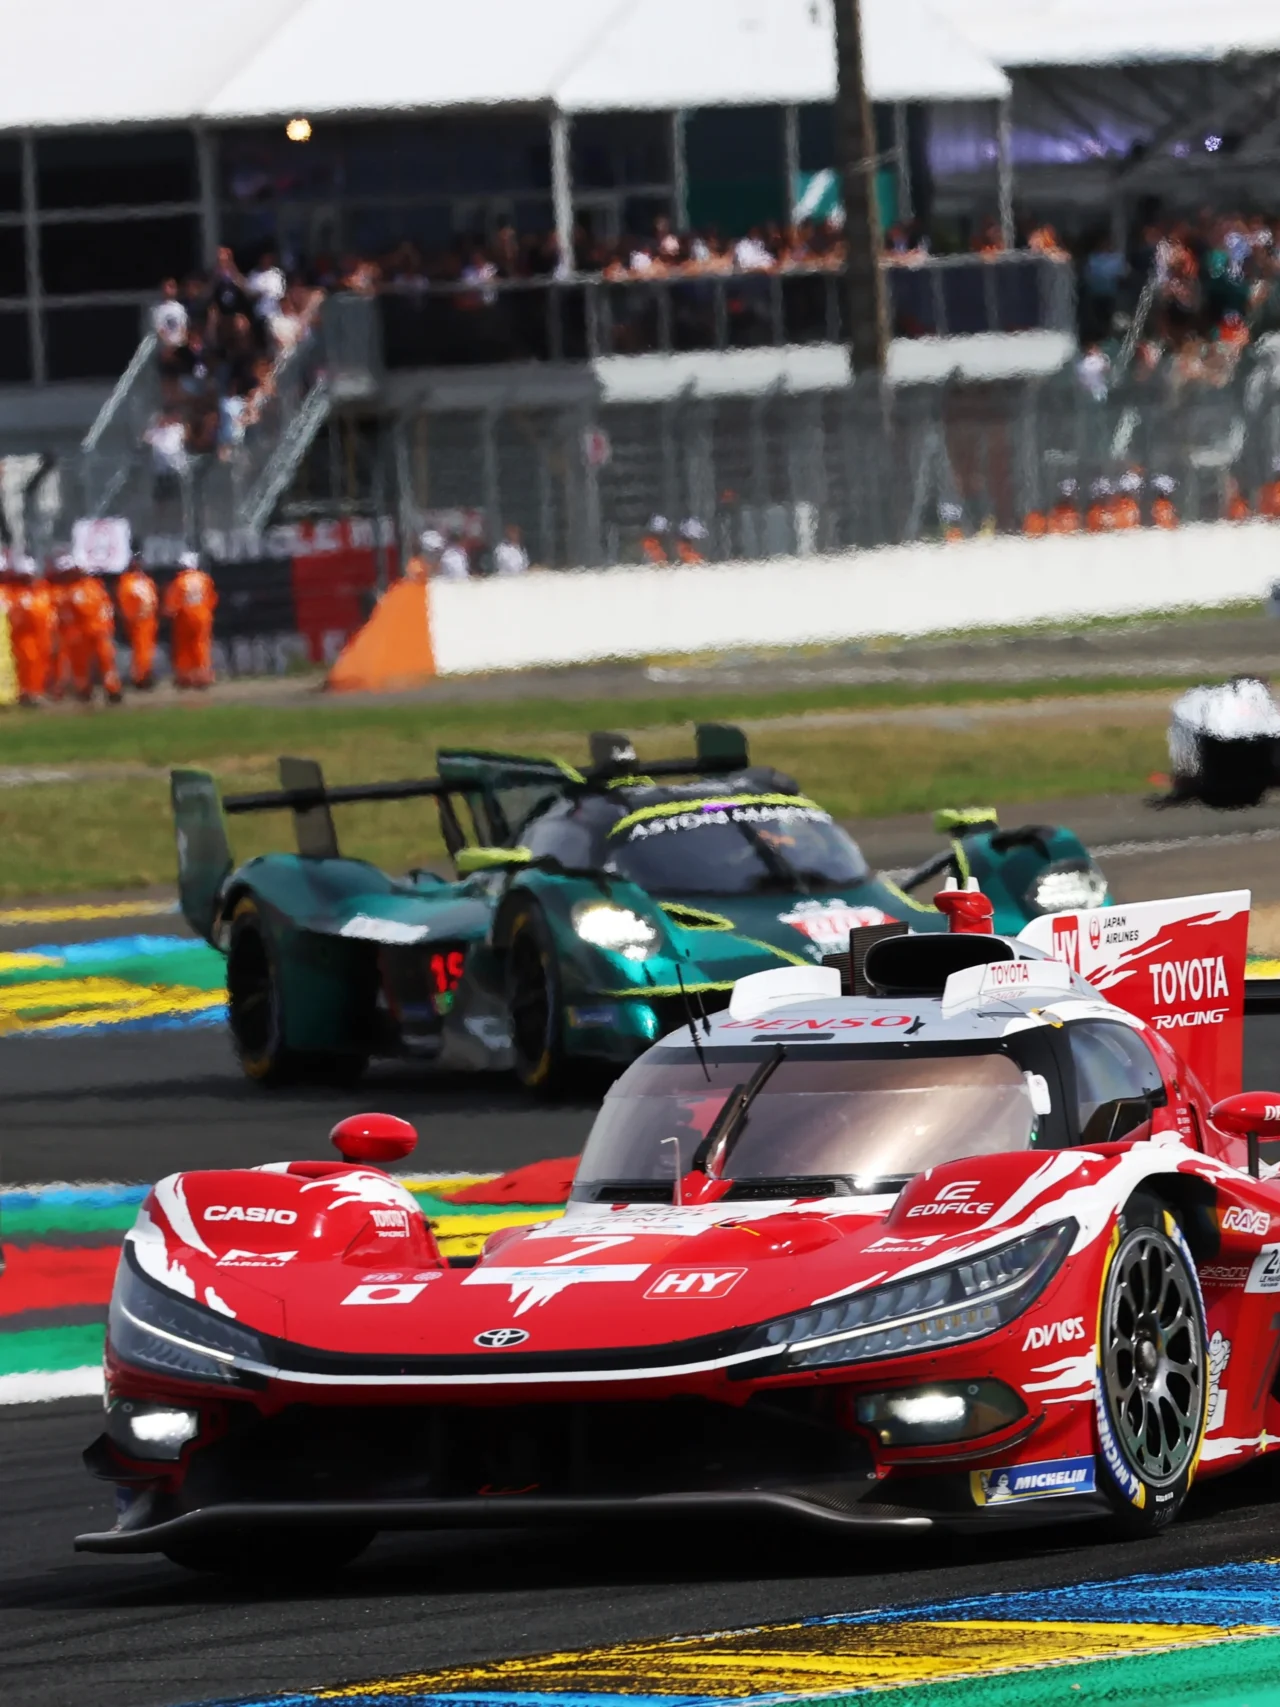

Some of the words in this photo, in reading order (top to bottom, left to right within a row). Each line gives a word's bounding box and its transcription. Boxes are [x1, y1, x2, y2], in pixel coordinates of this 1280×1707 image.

[1104, 916, 1126, 929] JAPAN
[1106, 930, 1139, 944] AIRLINES
[991, 963, 1029, 985] TOYOTA
[1149, 955, 1230, 1005] TOYOTA
[718, 1015, 912, 1030] DENSO
[1151, 1008, 1230, 1030] RACING
[203, 1205, 298, 1225] CASIO
[906, 1202, 995, 1218] EDIFICE
[1222, 1206, 1271, 1236] RAYS
[543, 1235, 635, 1264] 7
[860, 1246, 927, 1254] MARELLI
[653, 1272, 738, 1293] HY
[1014, 1469, 1088, 1490] MICHELIN
